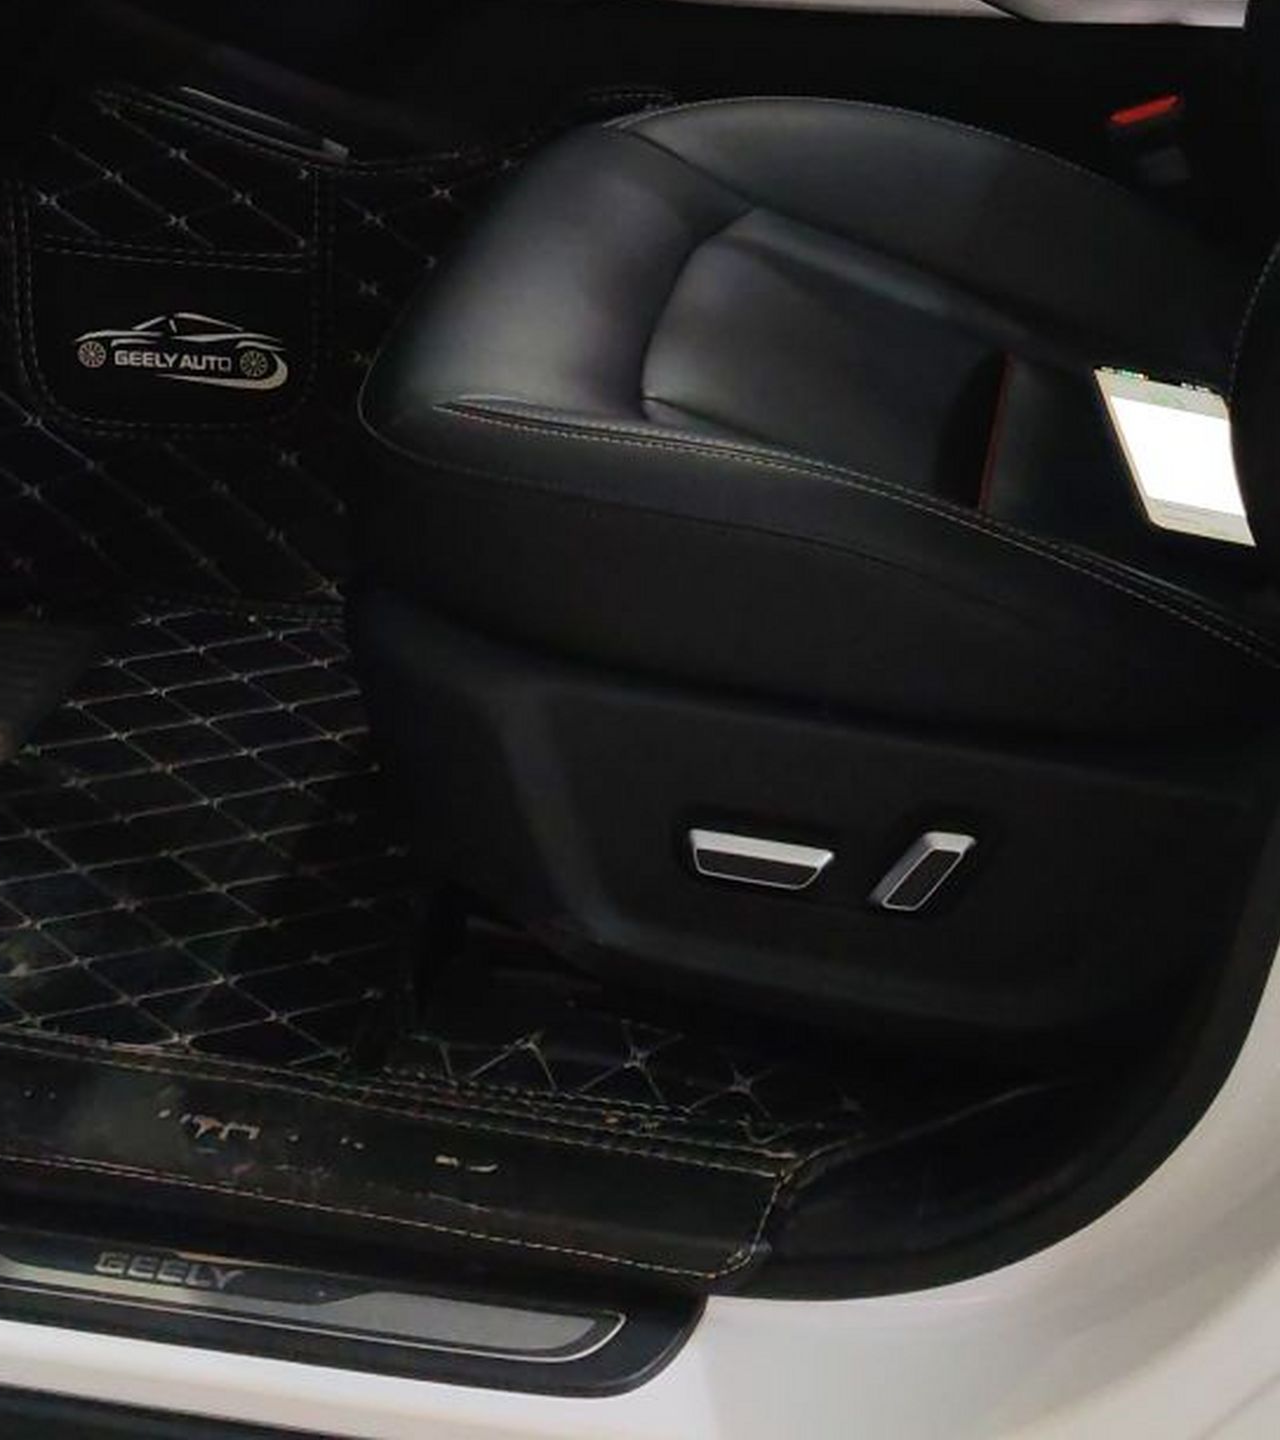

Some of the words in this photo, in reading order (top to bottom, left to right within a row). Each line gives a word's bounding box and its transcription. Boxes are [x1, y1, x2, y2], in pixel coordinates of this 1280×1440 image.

[114, 349, 179, 369] GEELY
[179, 354, 232, 372] AUTO
[94, 1251, 246, 1291] GEELY
